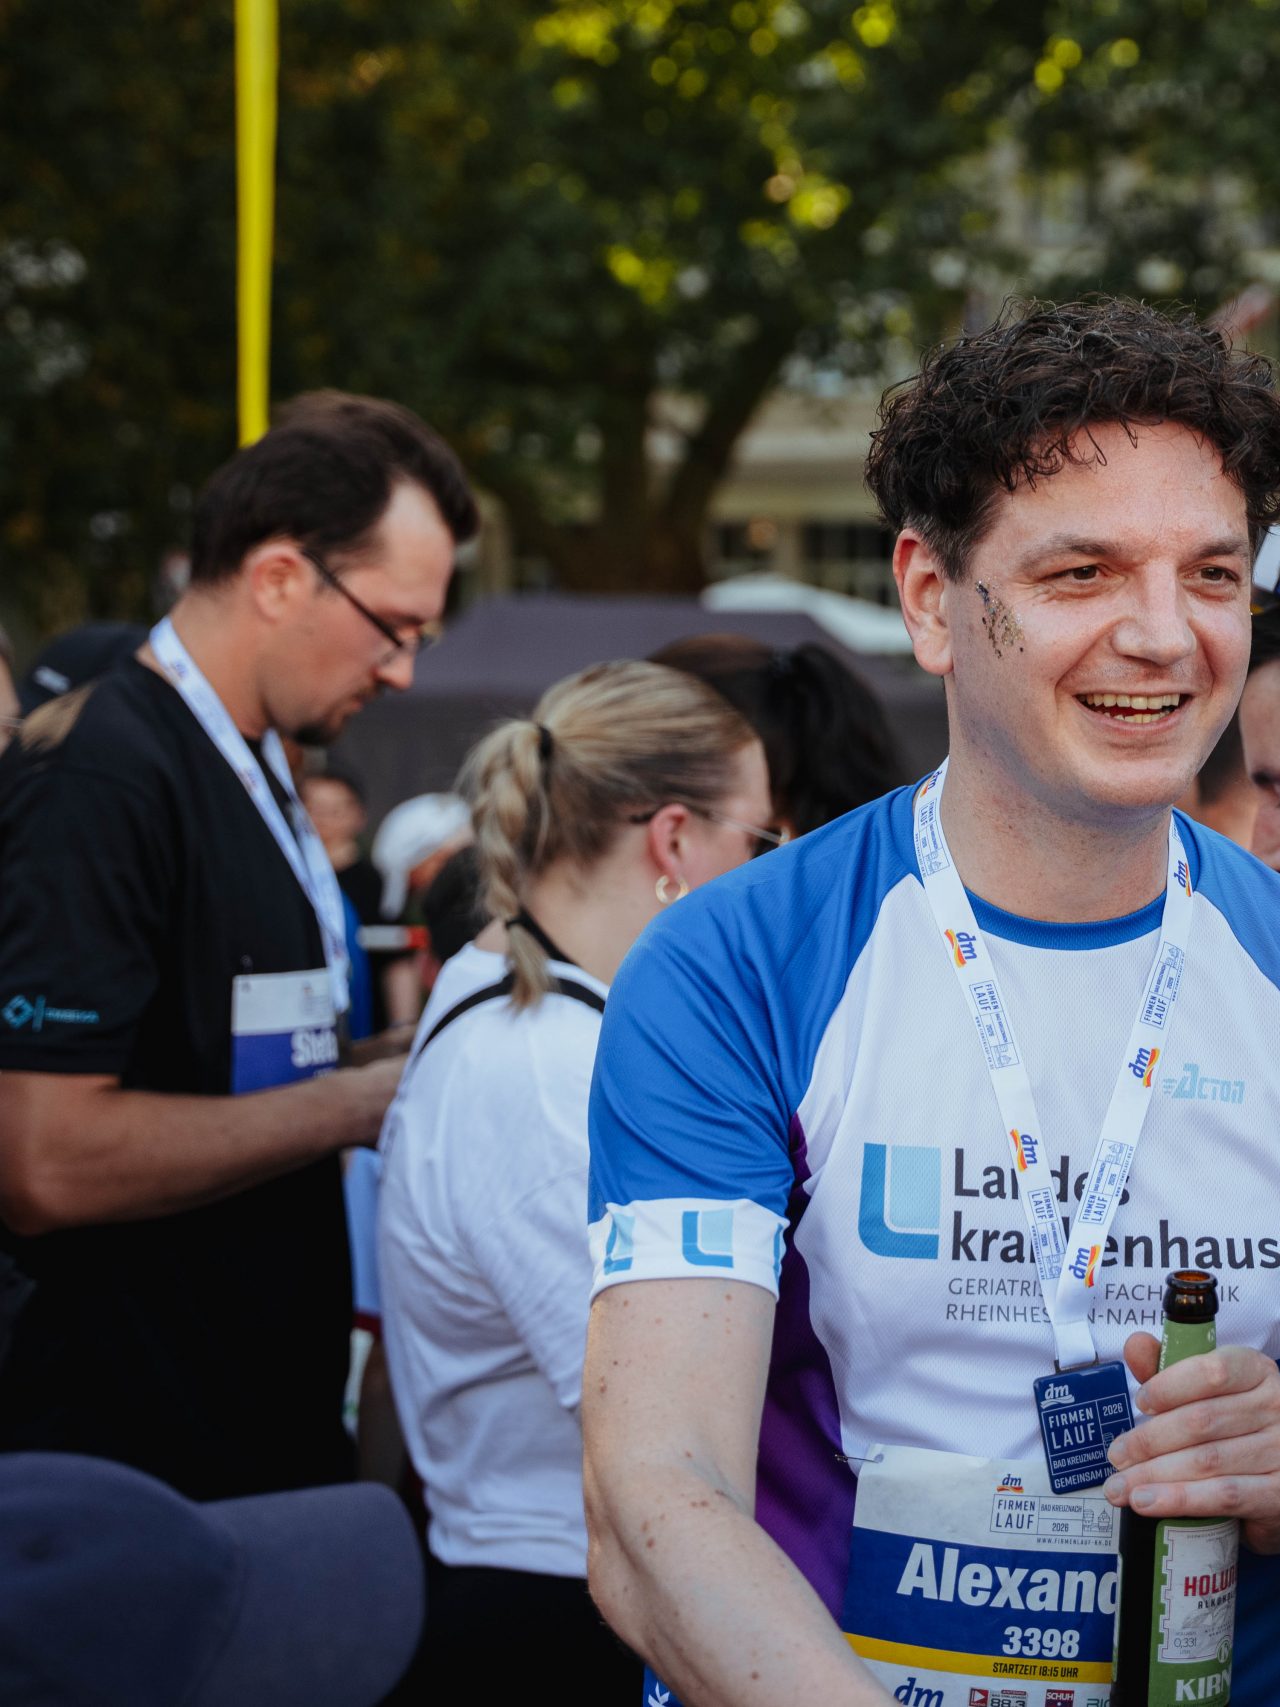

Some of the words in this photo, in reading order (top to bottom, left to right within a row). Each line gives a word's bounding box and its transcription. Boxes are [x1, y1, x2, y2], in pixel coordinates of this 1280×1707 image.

[1174, 860, 1187, 887] dm
[956, 931, 977, 961] dm
[973, 985, 991, 1012] LAUF
[985, 983, 999, 1009] FIRMEN
[1143, 995, 1157, 1021] FIRMEN
[1151, 998, 1168, 1025] LAUF
[1129, 1047, 1151, 1079] dm
[1020, 1133, 1038, 1164] dm
[1031, 1192, 1046, 1220] LAUF
[1042, 1191, 1054, 1218] FIRMEN
[1082, 1194, 1096, 1220] FIRMEN
[1092, 1196, 1108, 1222] LAUF
[1069, 1247, 1090, 1280] dm
[1105, 1283, 1240, 1302] FACHIK
[1045, 1383, 1069, 1400] dm
[1048, 1407, 1094, 1429] FIRMEN
[1102, 1403, 1123, 1416] 2026
[1051, 1422, 1096, 1449] LAUF
[1053, 1459, 1066, 1469] BAD
[1067, 1450, 1104, 1466] KREUZNACH
[1002, 1474, 1022, 1486] dm
[1054, 1469, 1102, 1489] GEMEINSAM
[997, 1499, 1036, 1511] FIRMEN
[1052, 1505, 1082, 1513] KREUZNACH
[995, 1513, 1034, 1529] LAUF
[1052, 1522, 1069, 1532] 2026
[1183, 1564, 1236, 1596] HOLUN
[1002, 1625, 1080, 1659] 3398
[992, 1662, 1037, 1676] STARTZEIT
[1039, 1664, 1058, 1677] 18:15
[1060, 1666, 1079, 1678] UHR
[894, 1677, 945, 1707] dm
[1046, 1691, 1074, 1701] SCHUH
[1175, 1669, 1232, 1701] KIRN
